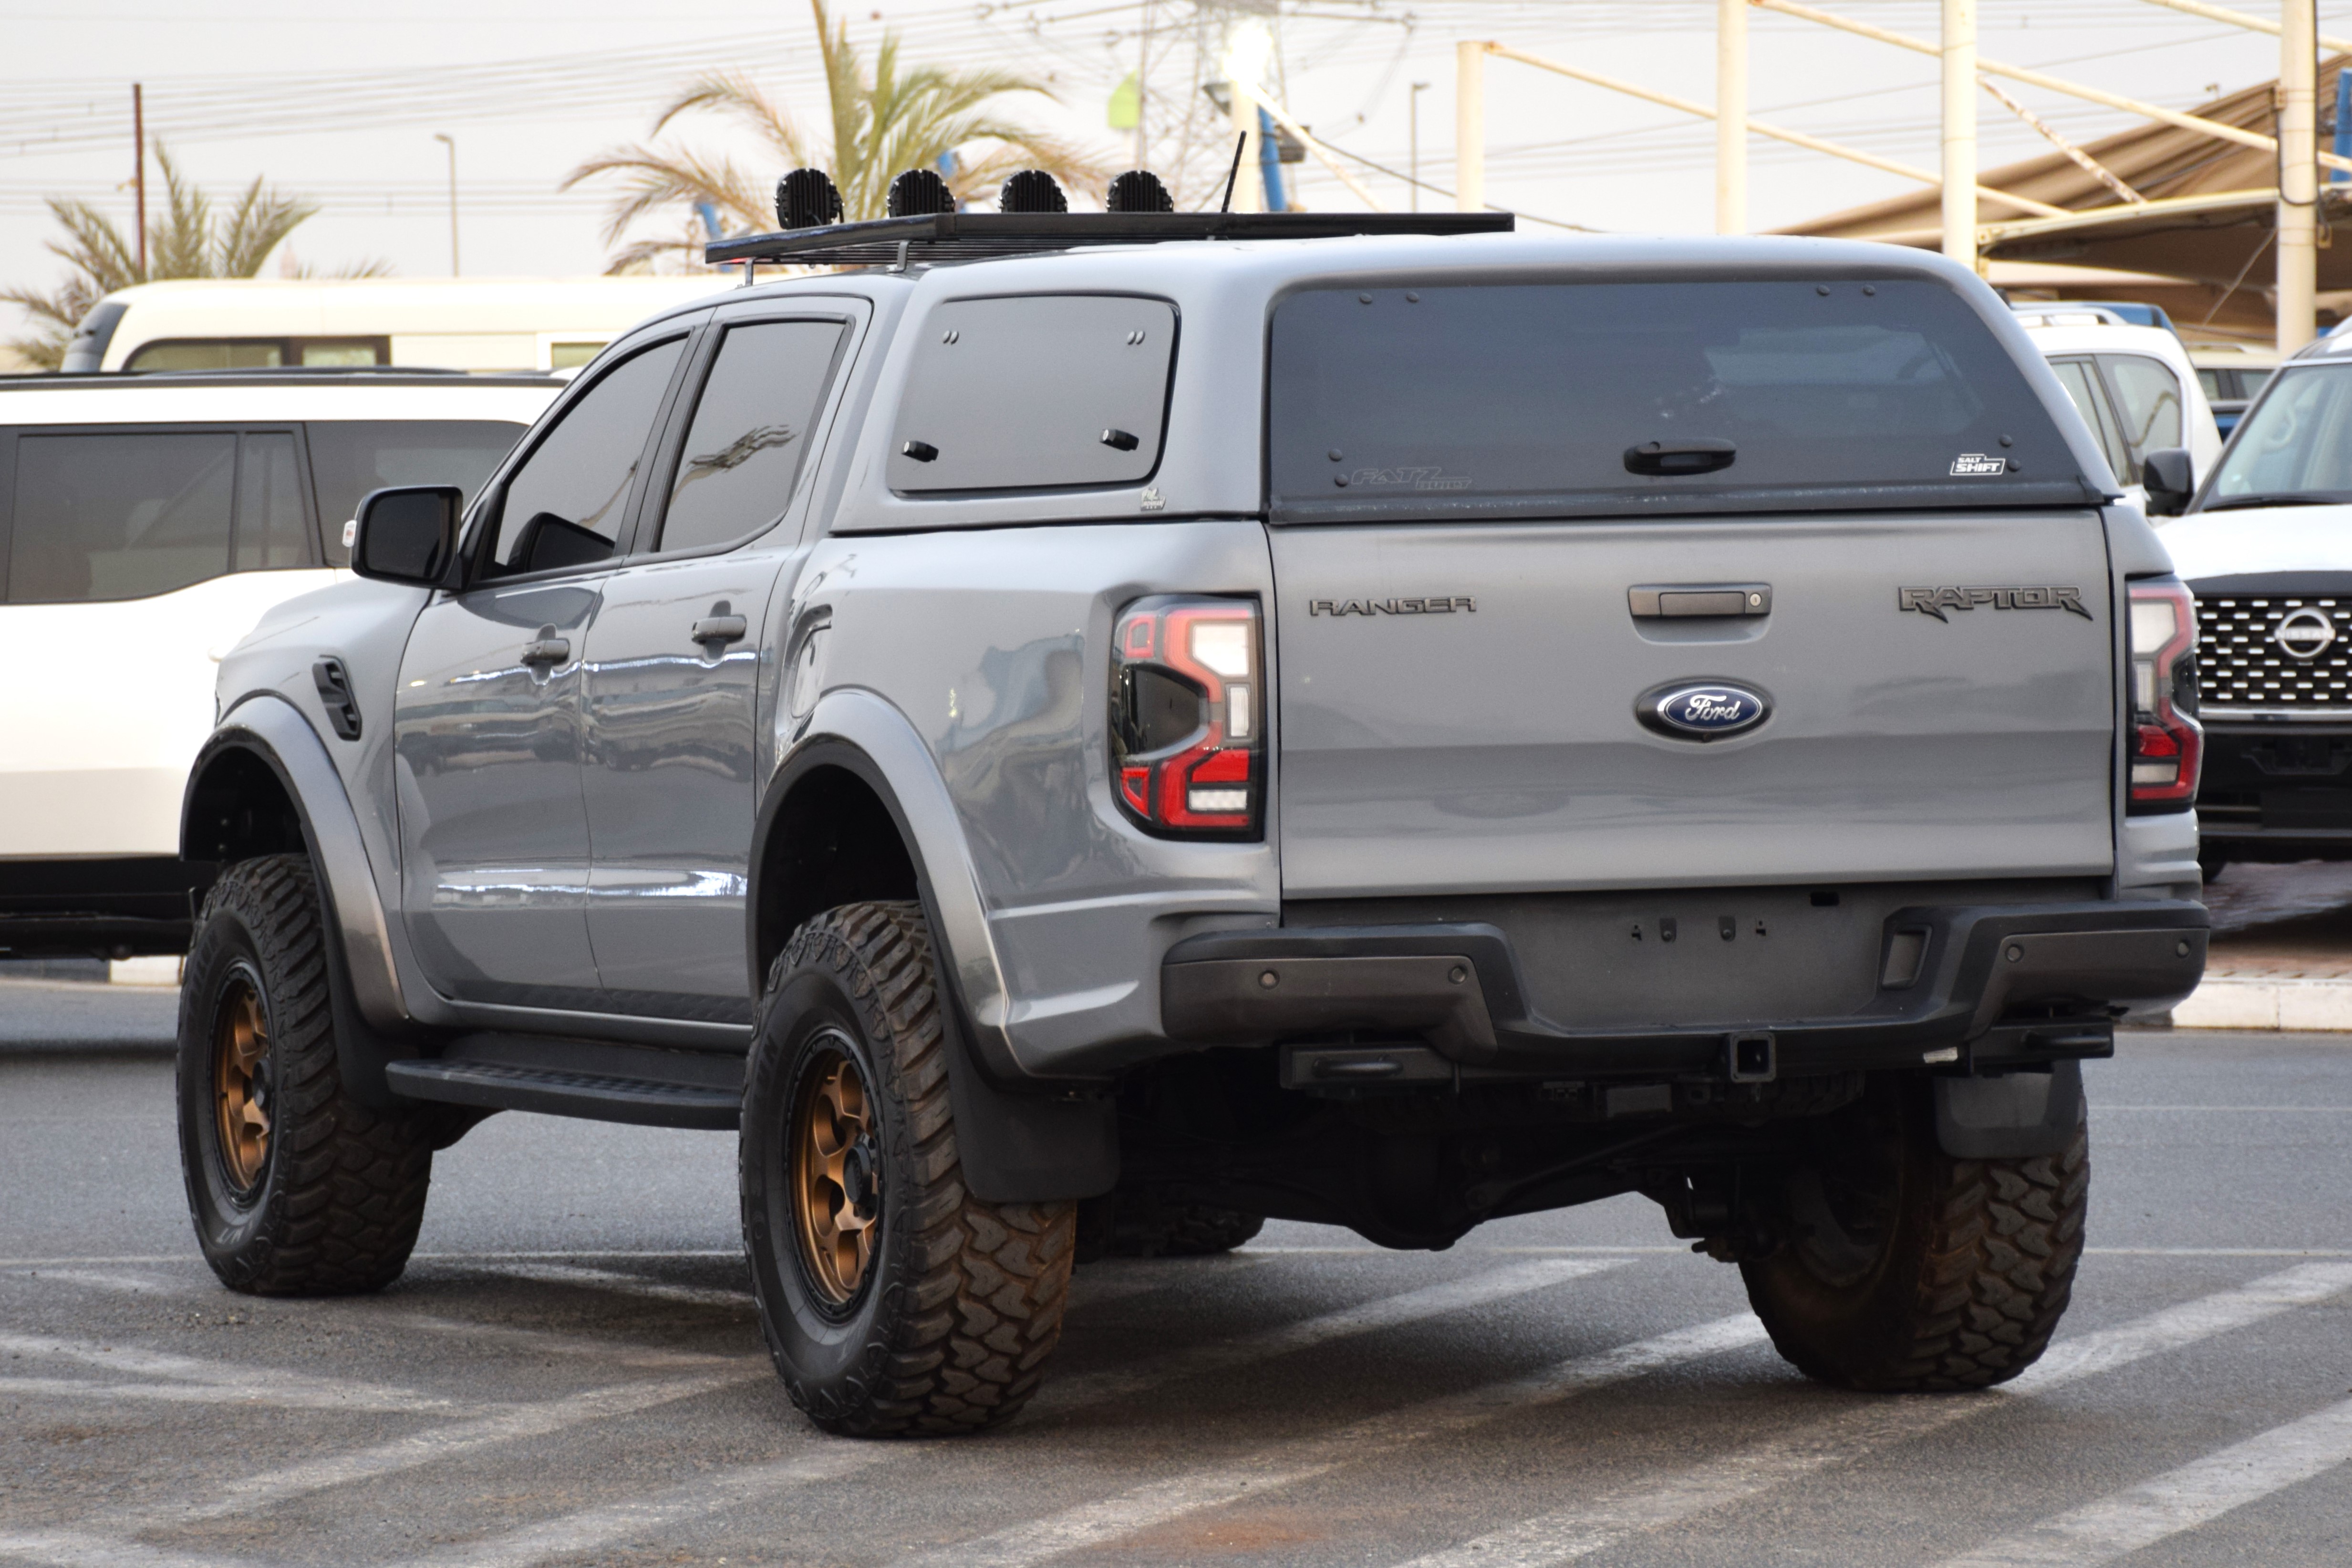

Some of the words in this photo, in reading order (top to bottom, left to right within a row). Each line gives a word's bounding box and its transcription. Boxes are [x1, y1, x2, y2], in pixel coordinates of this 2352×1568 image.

[1955, 463, 2000, 472] SHIFT
[1310, 596, 1477, 616] RANGER
[1898, 586, 2093, 623] RAPTOR
[1685, 694, 1741, 721] Ford
